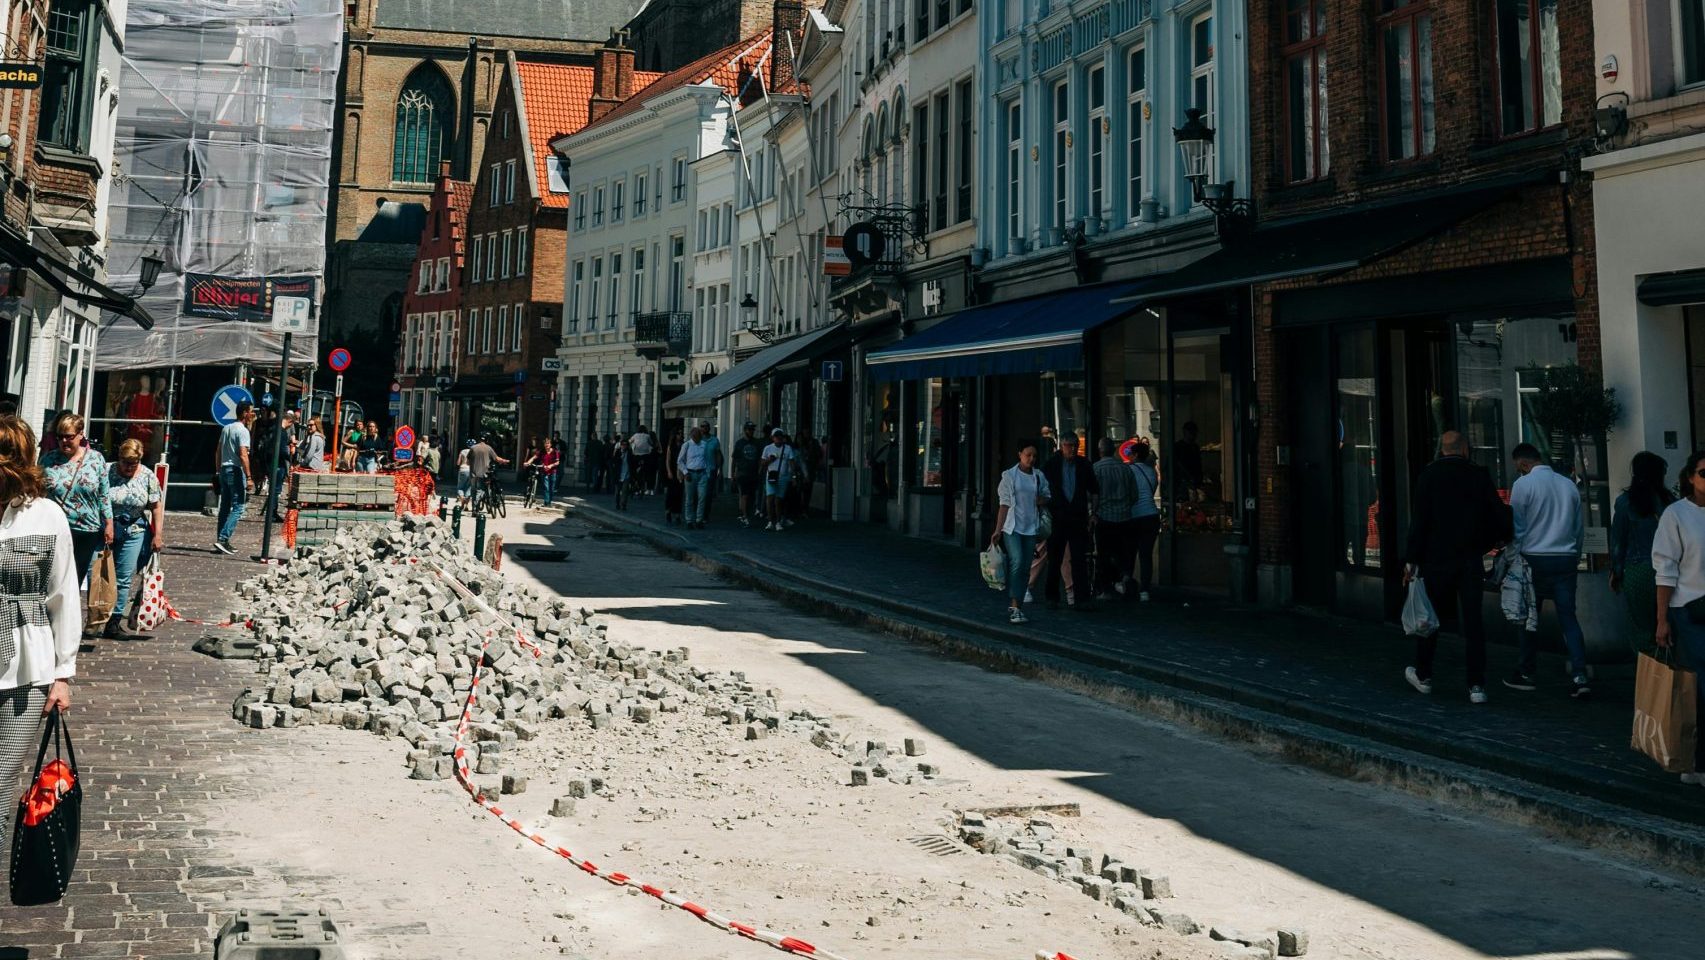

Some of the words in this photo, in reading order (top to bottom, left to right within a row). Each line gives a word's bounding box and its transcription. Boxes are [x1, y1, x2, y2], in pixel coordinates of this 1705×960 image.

[0, 70, 38, 81] acha
[198, 287, 260, 306] Olivier
[292, 300, 305, 316] P
